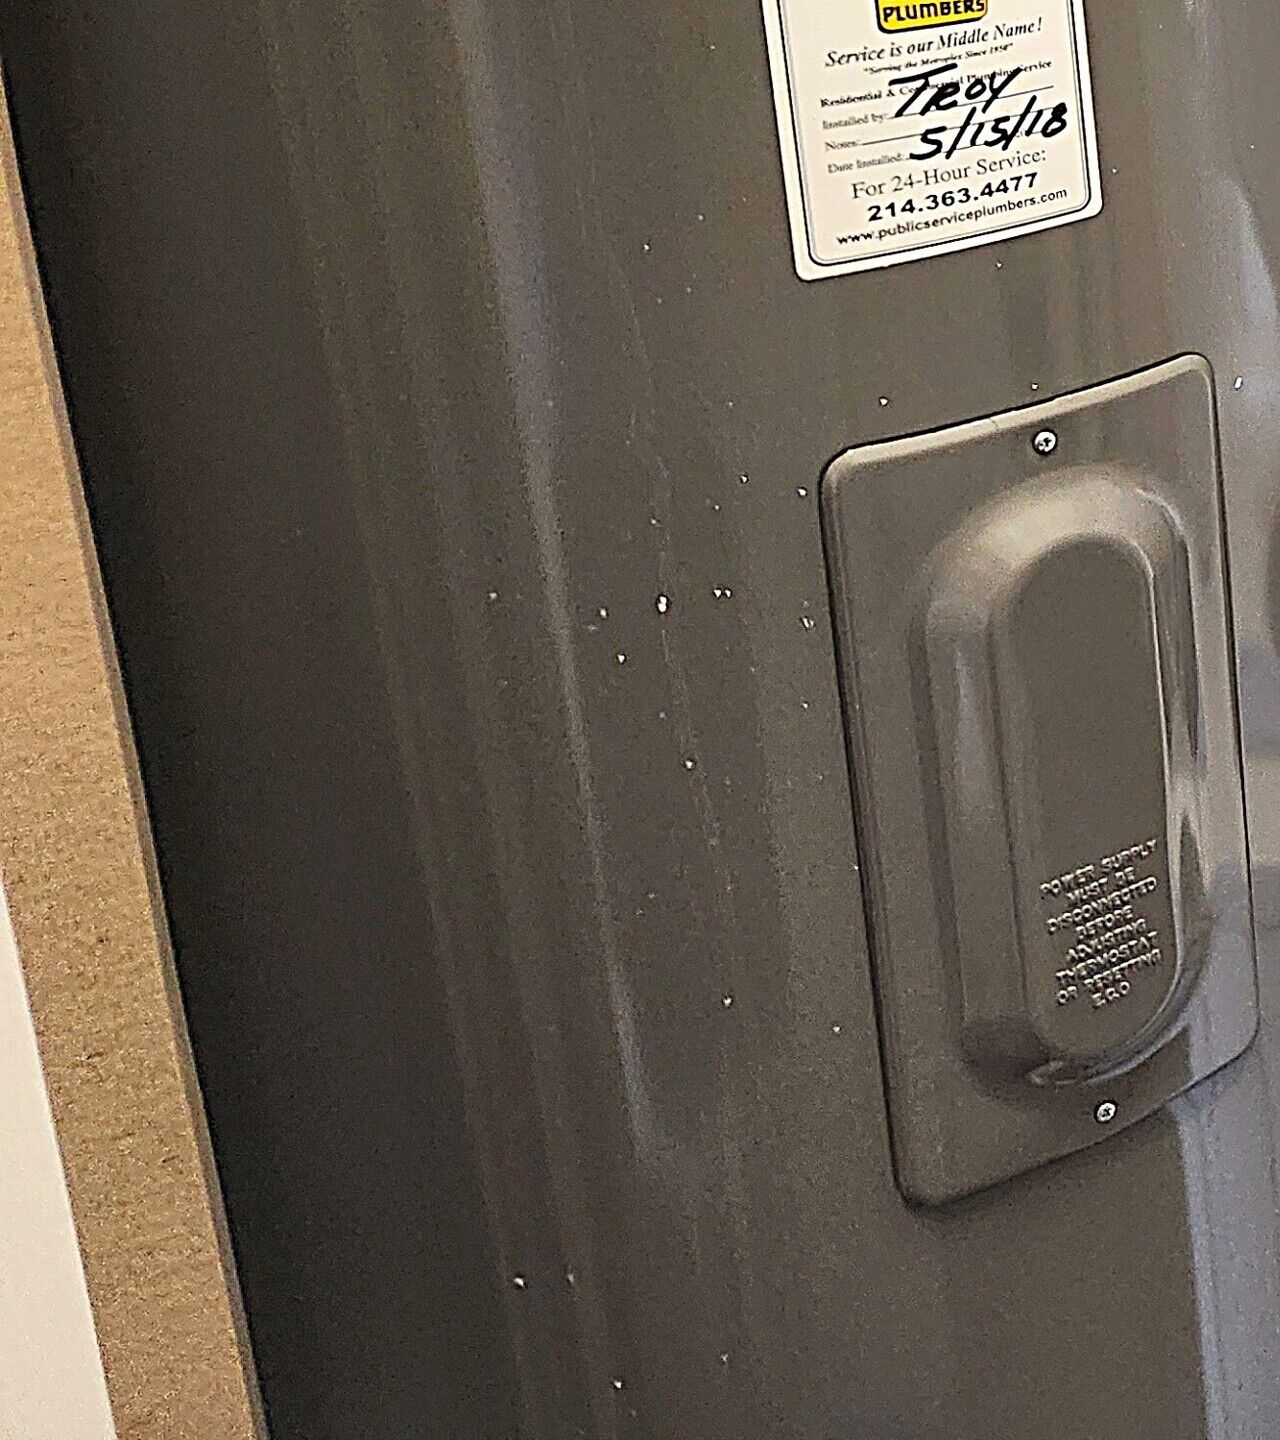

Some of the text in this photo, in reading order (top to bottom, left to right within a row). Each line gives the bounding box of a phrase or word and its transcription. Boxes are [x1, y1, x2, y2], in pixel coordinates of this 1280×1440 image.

[825, 17, 1043, 68] Service is our Middle Name!
[908, 95, 1069, 160] 5/15/18
[851, 147, 1048, 201] For 24-Hour Service:
[867, 170, 1039, 223] 214.363.4477
[836, 187, 1069, 246] www.publicserviceplumbers.com
